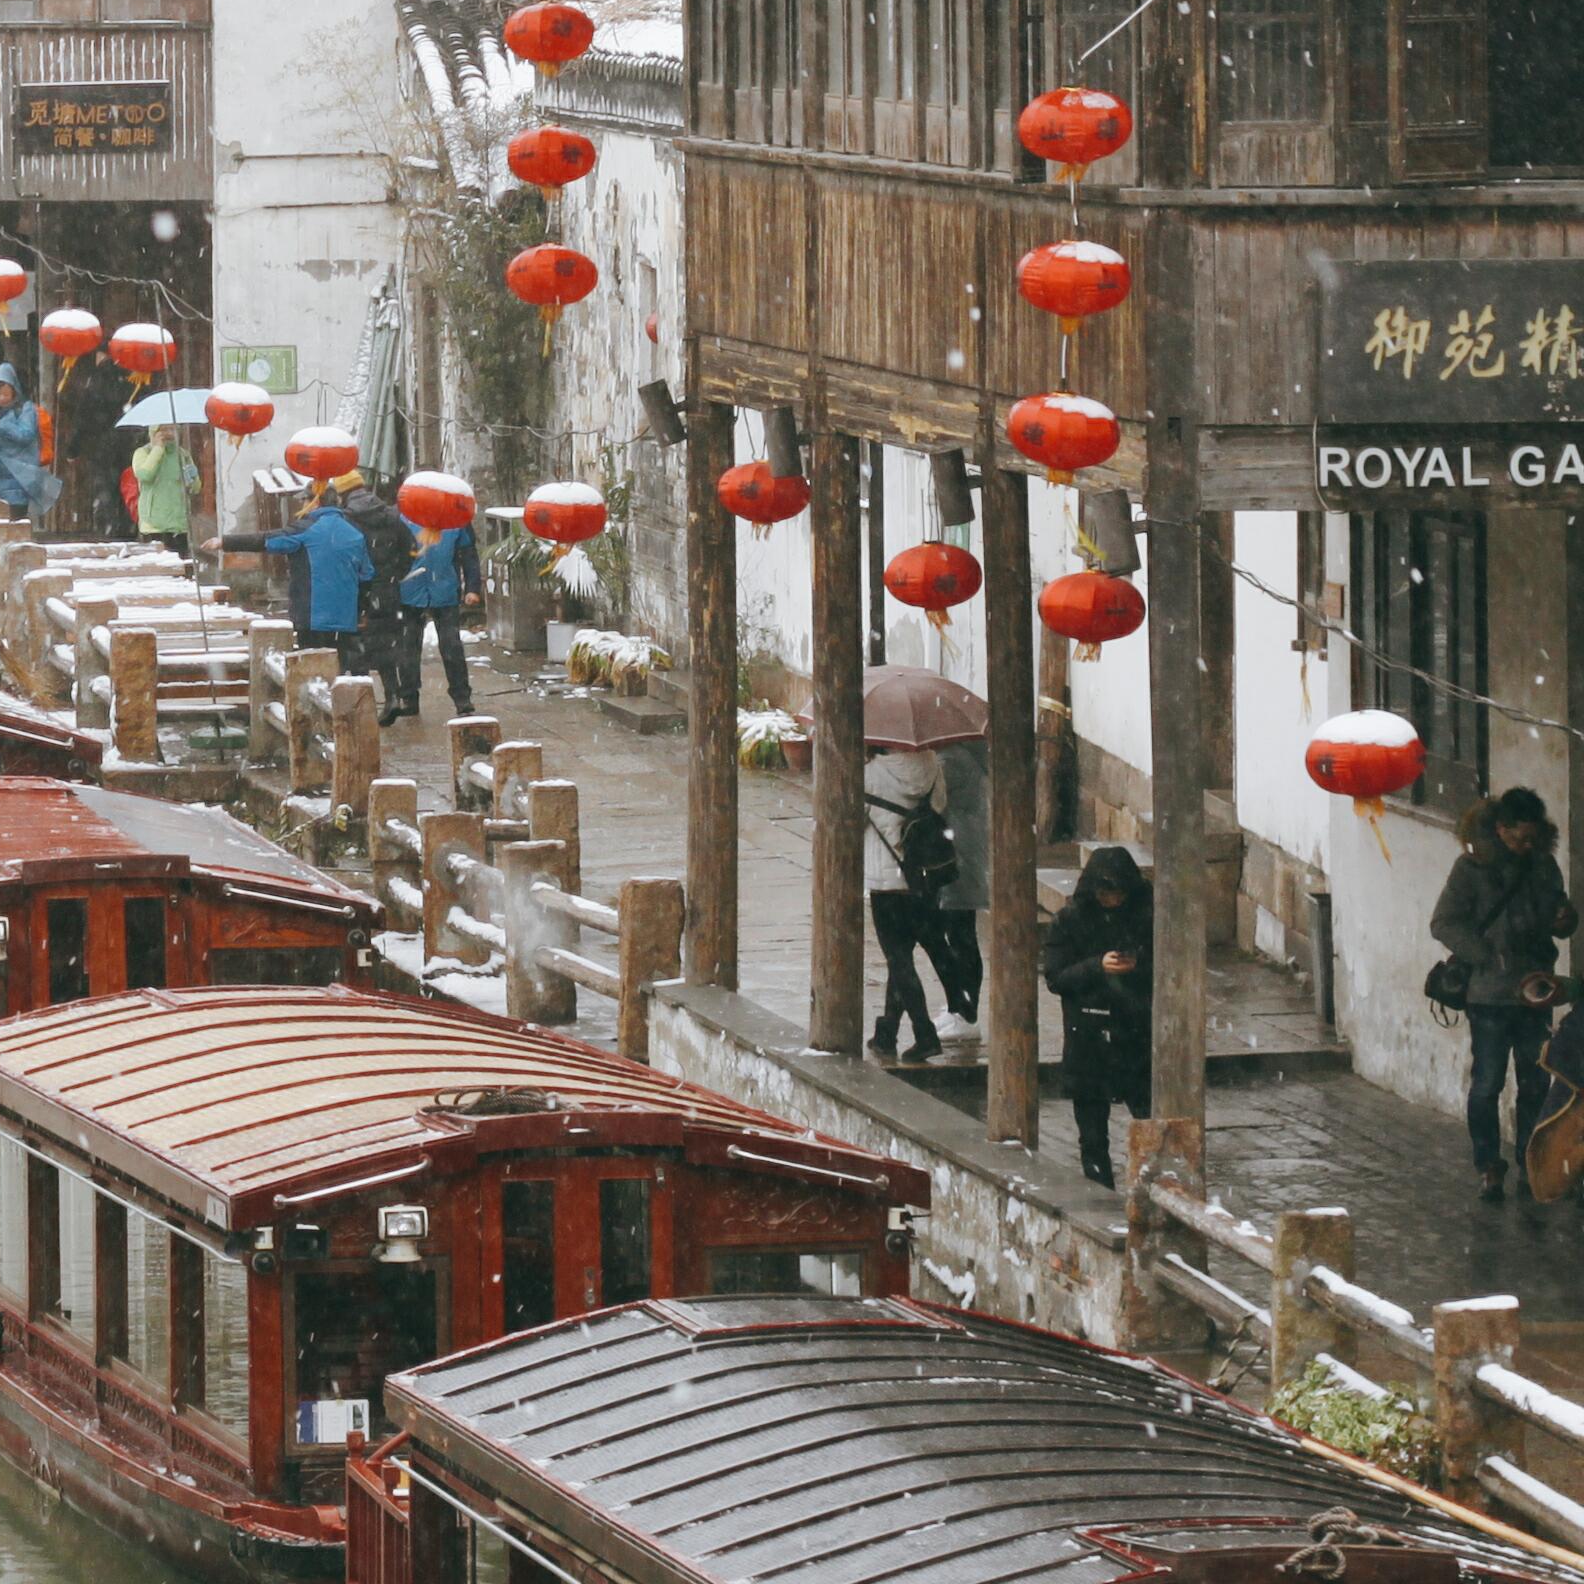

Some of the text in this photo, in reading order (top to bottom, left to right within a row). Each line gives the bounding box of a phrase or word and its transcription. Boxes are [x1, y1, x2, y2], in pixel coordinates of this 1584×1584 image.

[1364, 304, 1584, 381] 御苑精
[1319, 444, 1584, 488] ROYAL GA
